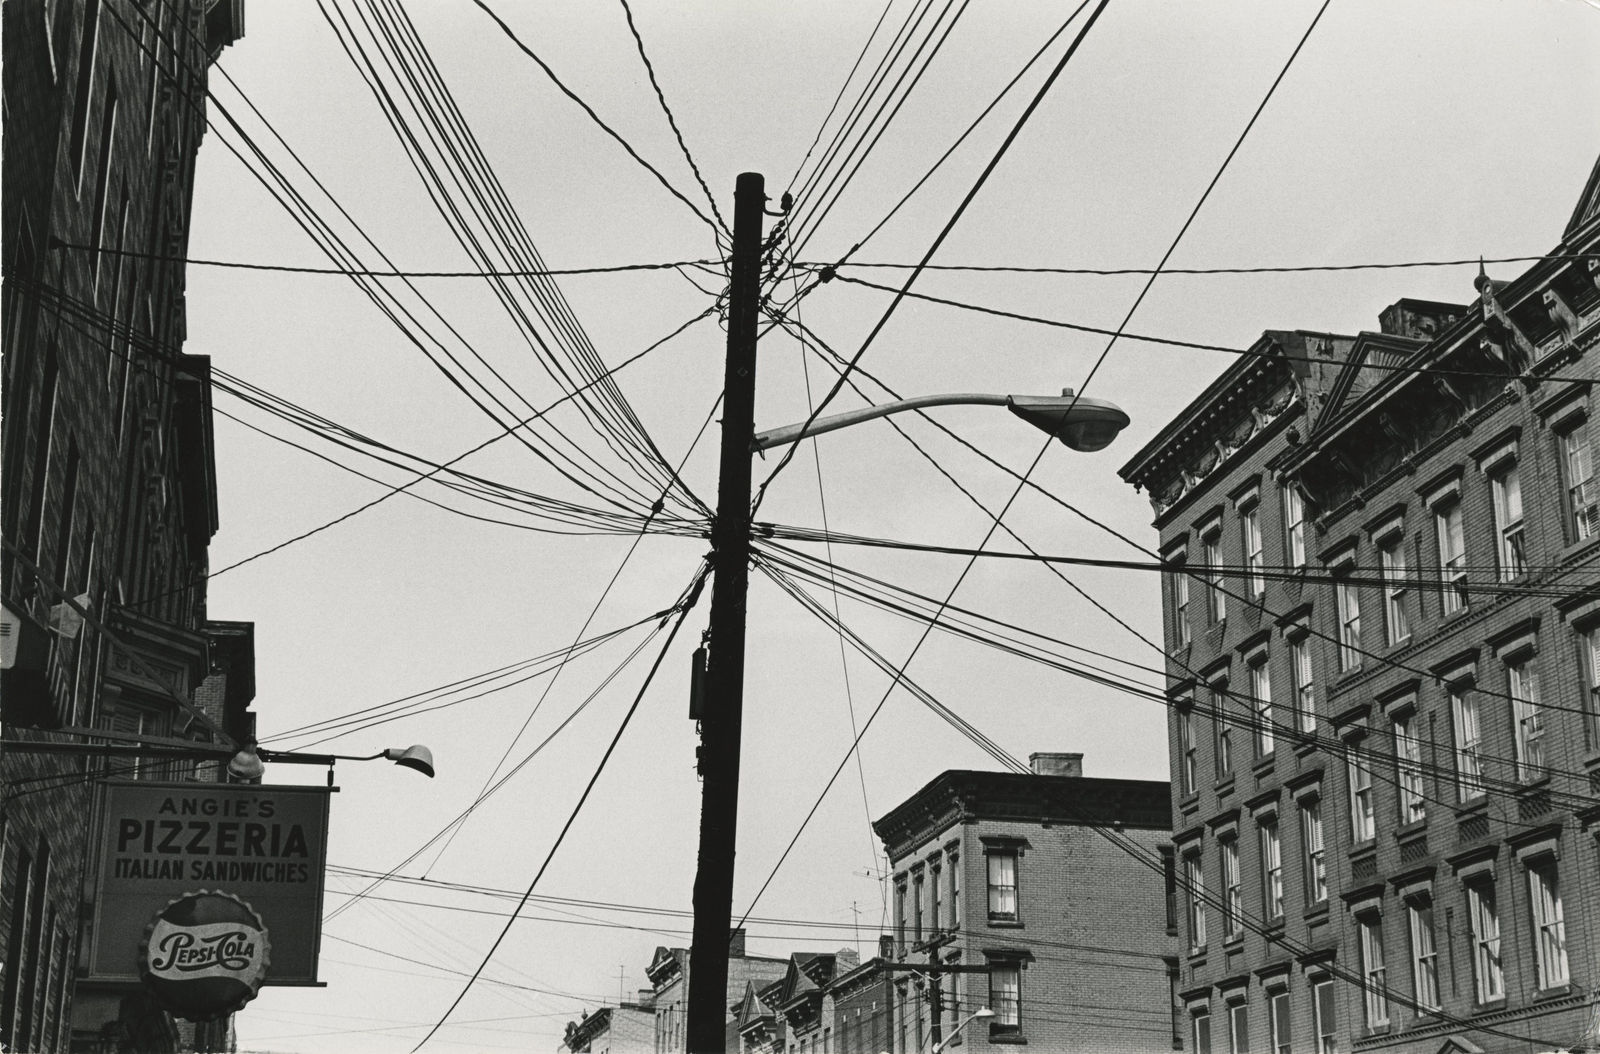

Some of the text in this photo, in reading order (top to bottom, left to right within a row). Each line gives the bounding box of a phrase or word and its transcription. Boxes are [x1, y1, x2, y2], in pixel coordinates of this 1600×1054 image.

[158, 797, 275, 818] ANGIE'S
[117, 818, 308, 858] PIZZERIA
[115, 858, 308, 883] ITALIAN SANDWICHES
